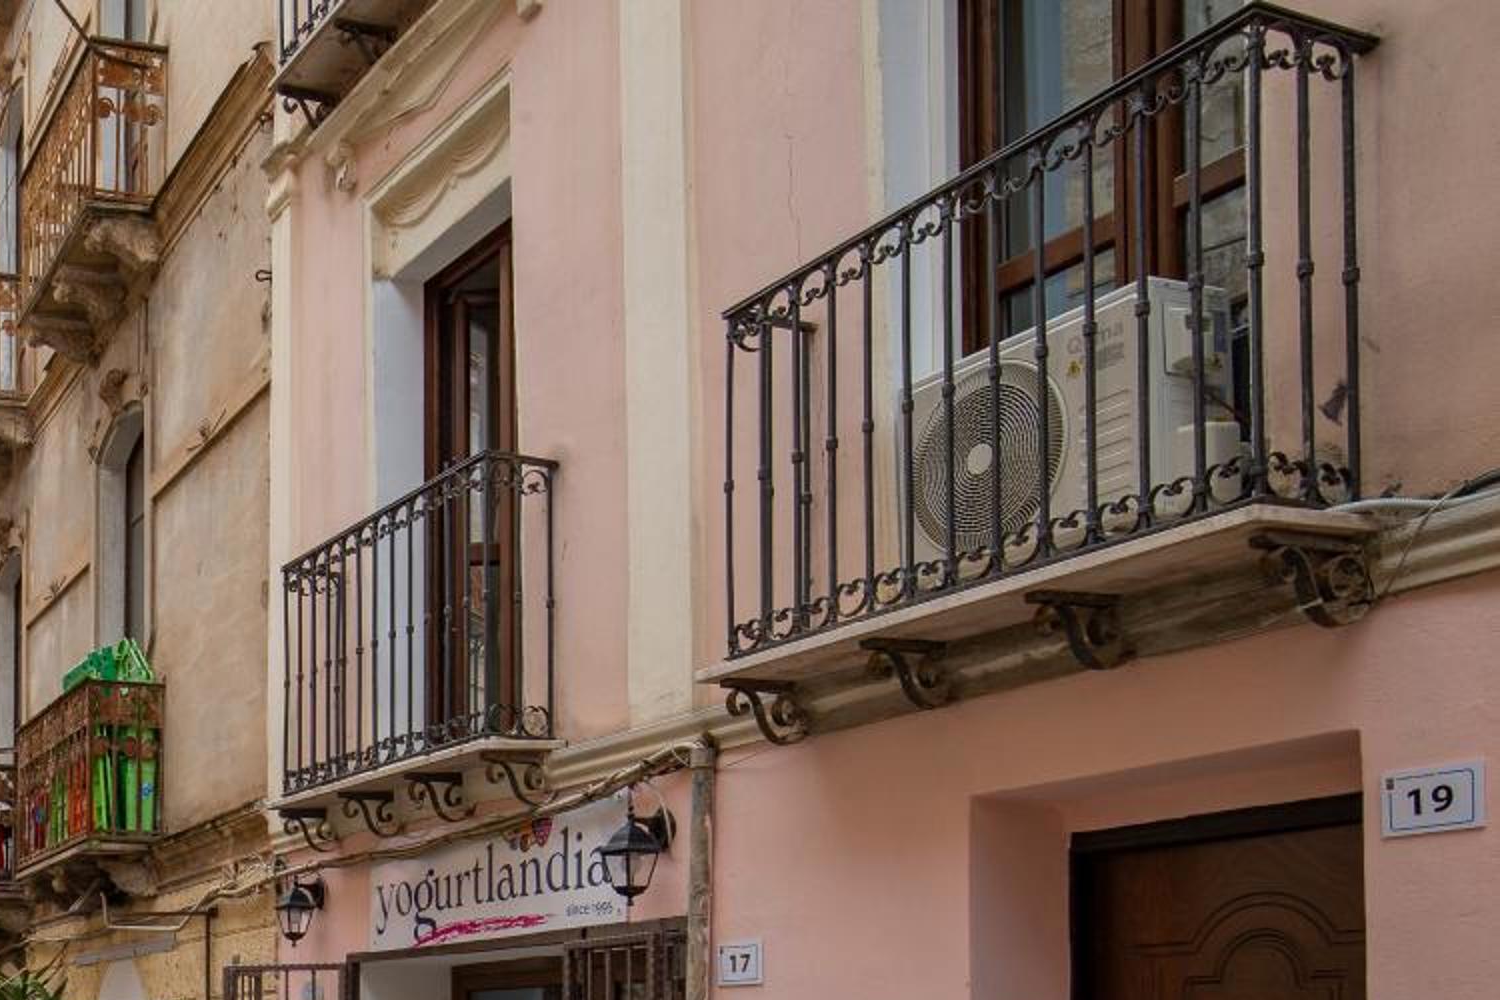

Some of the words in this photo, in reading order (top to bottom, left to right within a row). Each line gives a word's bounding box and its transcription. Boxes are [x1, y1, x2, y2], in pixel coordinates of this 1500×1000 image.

[1407, 784, 1453, 816] 19
[375, 826, 613, 943] yogurtlandia
[729, 953, 751, 973] 17
